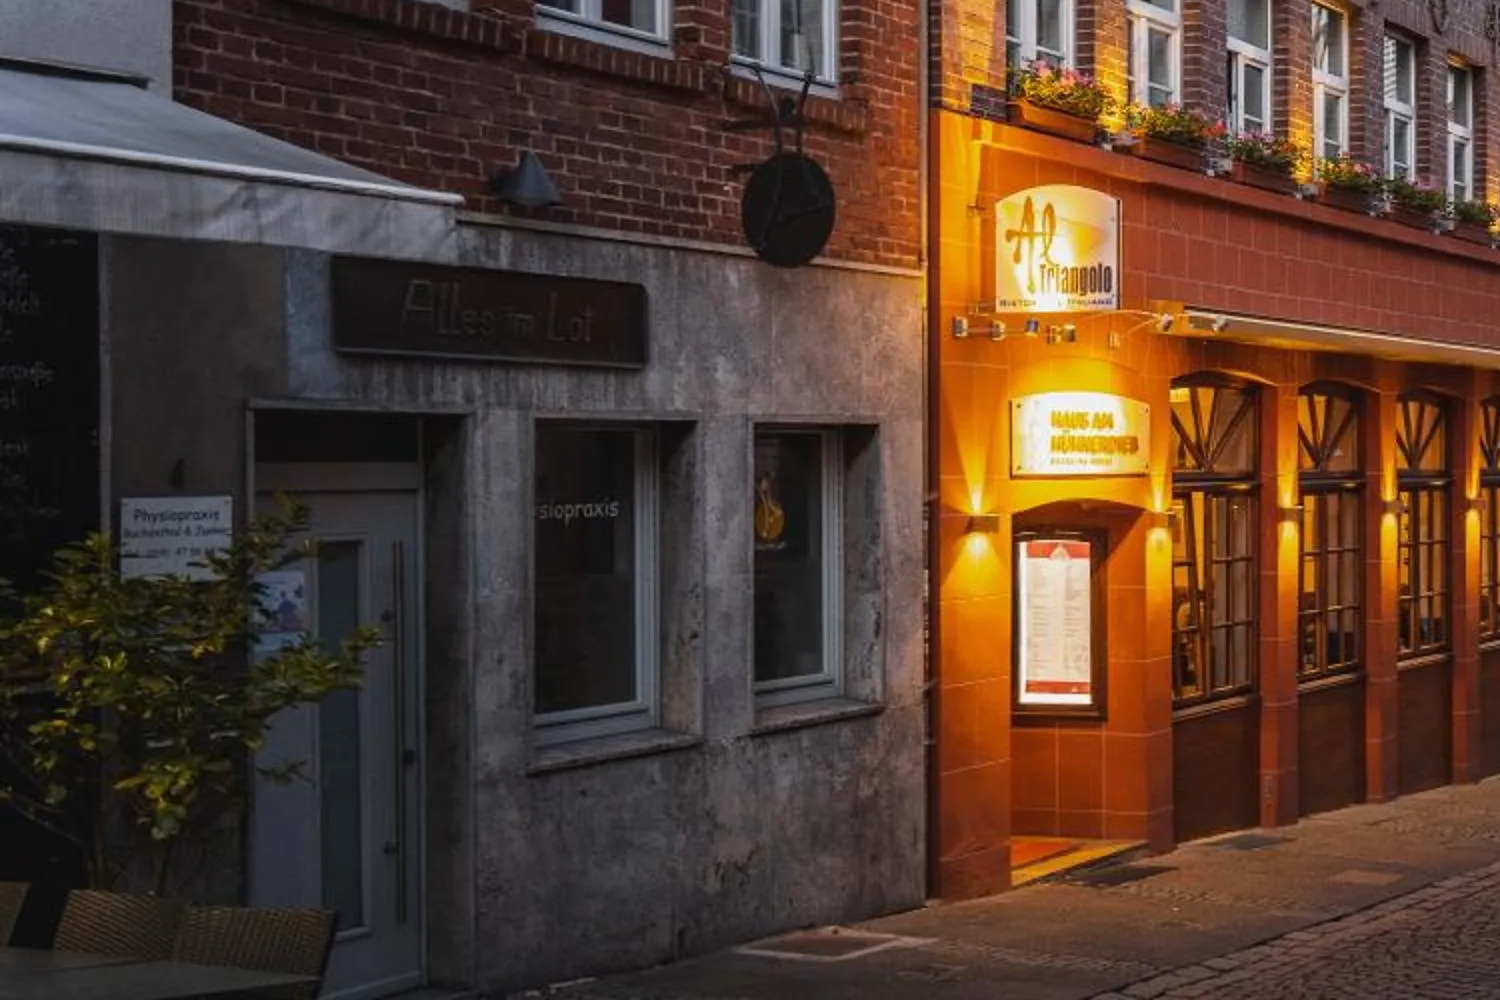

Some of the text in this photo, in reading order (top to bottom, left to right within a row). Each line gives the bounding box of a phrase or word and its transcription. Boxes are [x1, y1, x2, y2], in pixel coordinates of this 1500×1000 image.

[1039, 261, 1113, 296] Triangolo
[399, 278, 496, 337] Alles
[546, 290, 595, 344] Lot
[133, 508, 220, 524] Physiopraxis
